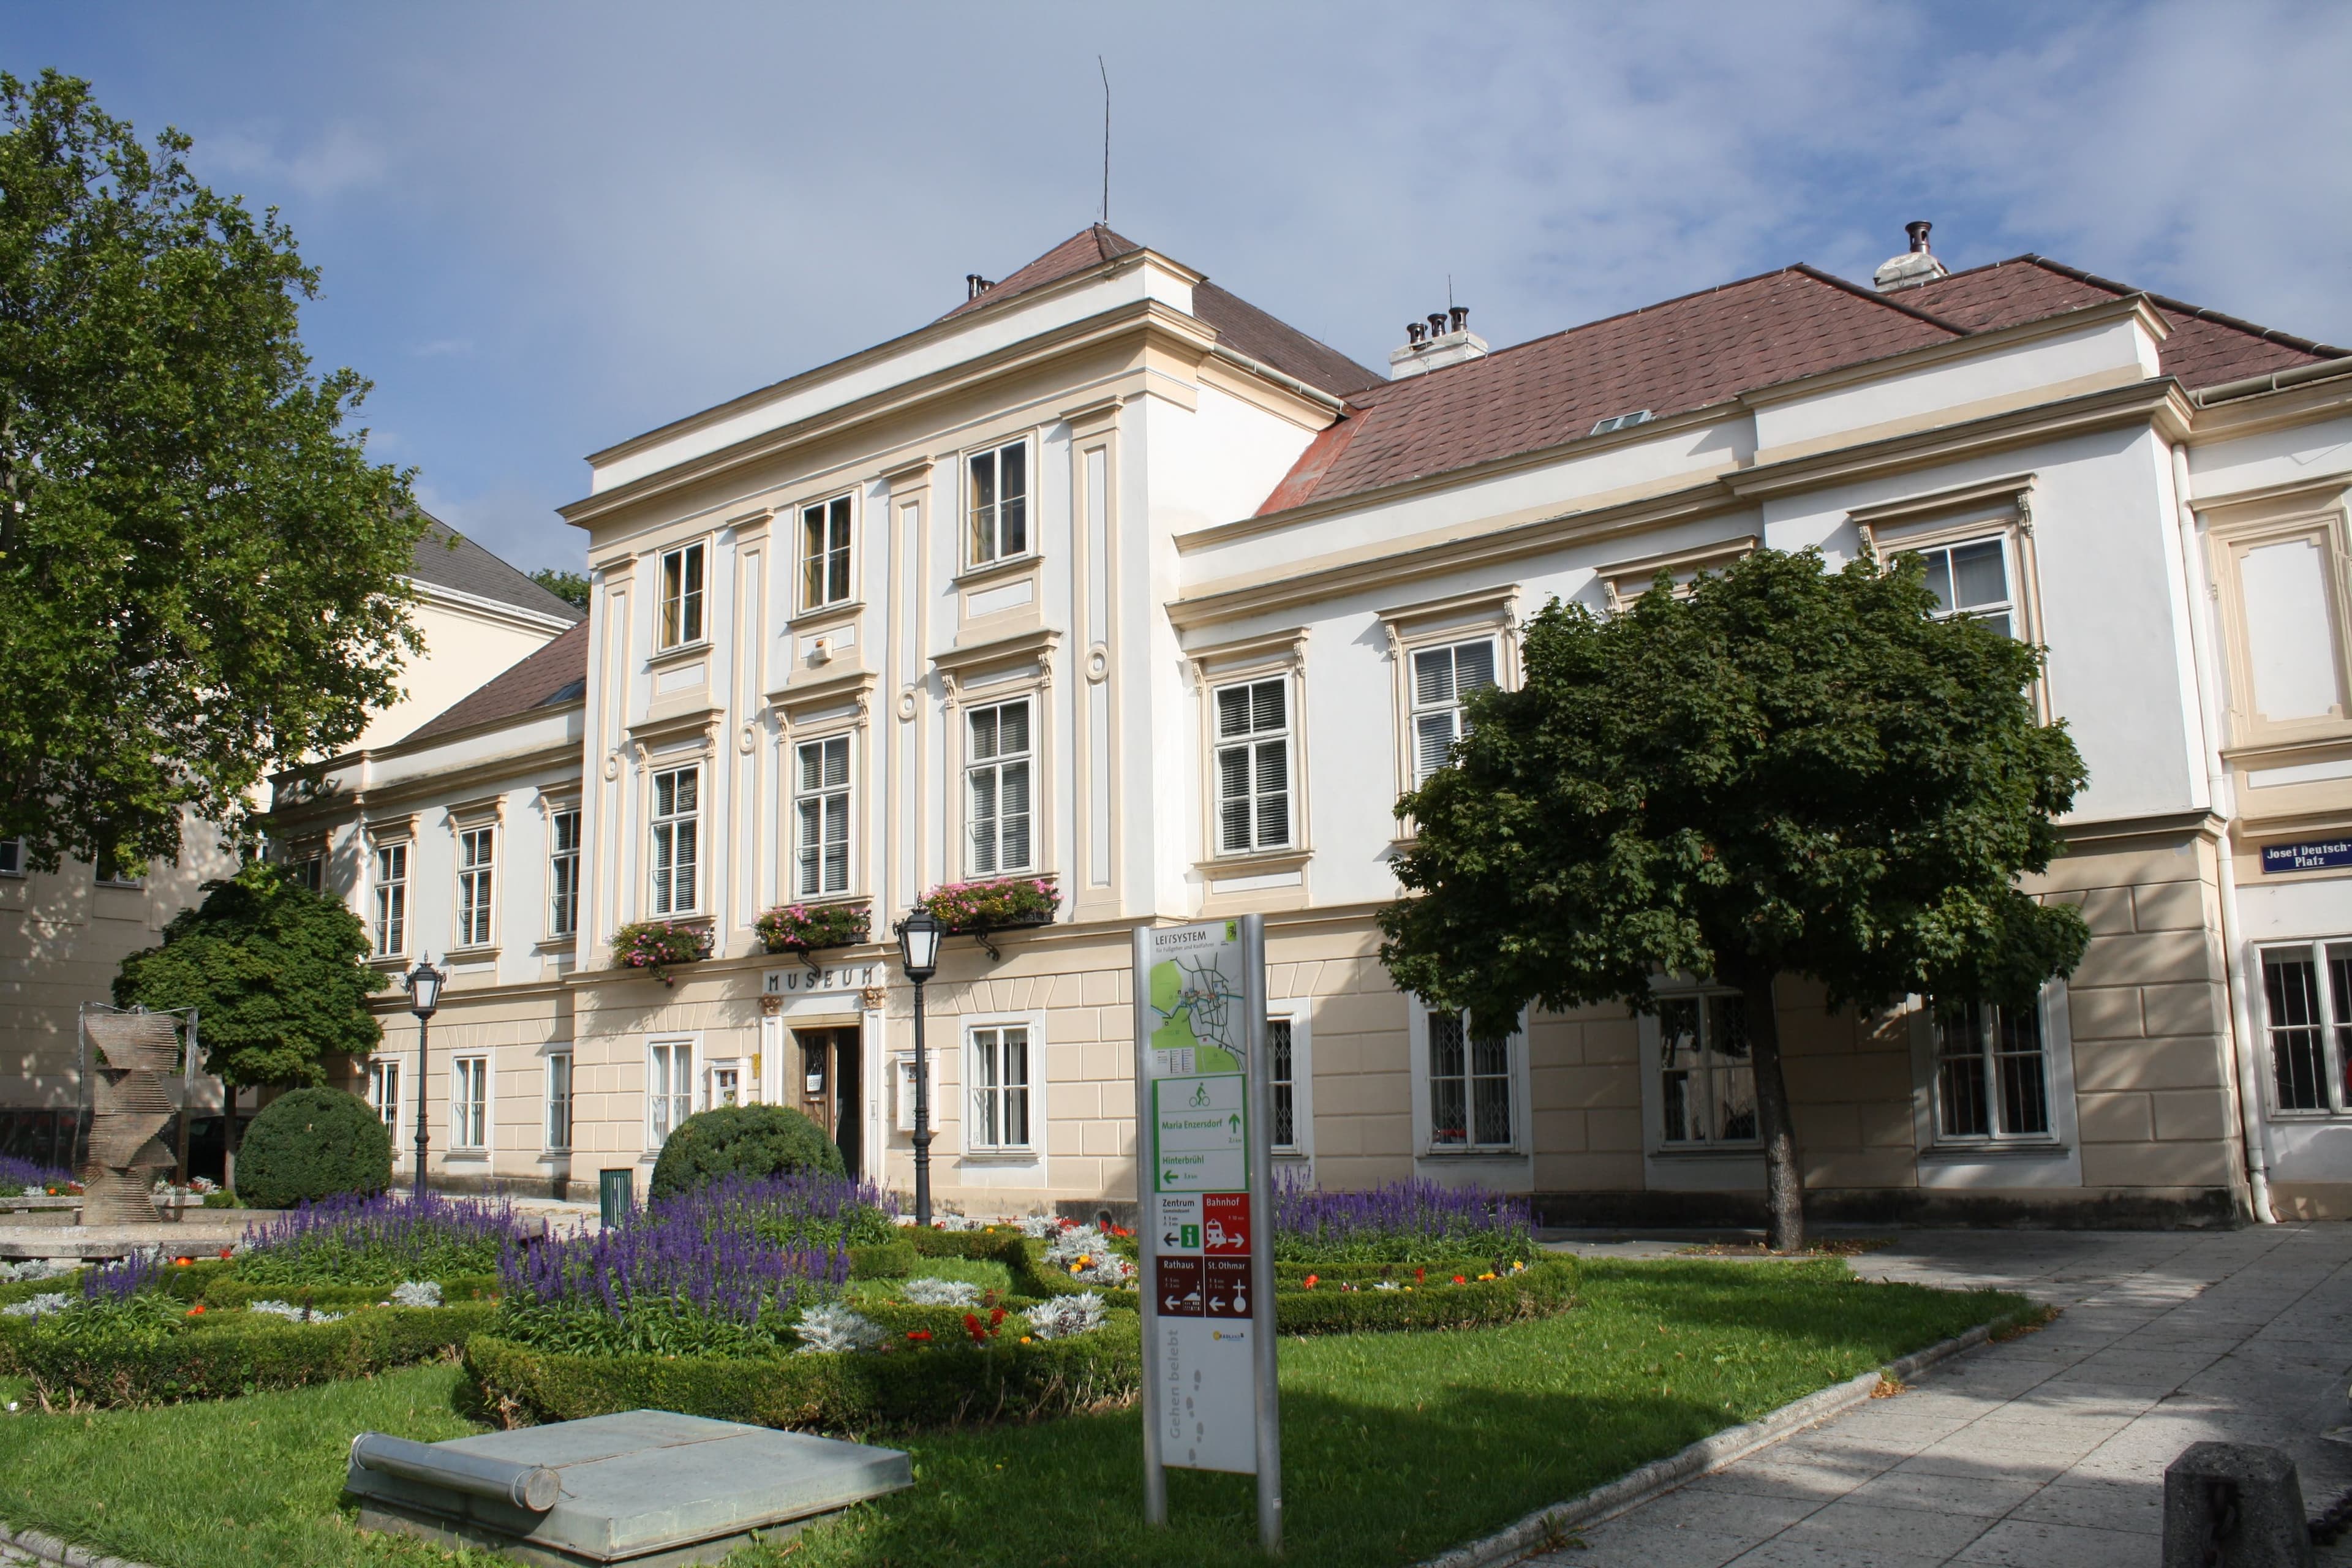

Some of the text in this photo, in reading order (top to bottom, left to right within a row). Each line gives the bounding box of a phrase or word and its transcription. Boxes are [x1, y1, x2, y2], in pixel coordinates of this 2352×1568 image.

[2267, 842, 2351, 859] Josef Deutsch-
[2295, 856, 2324, 867] Platz
[1156, 931, 1206, 945] LEITSYSTEM
[769, 967, 873, 992] MUSEUM
[1162, 1118, 1223, 1129] Maria Enzersdorf
[1163, 1155, 1204, 1164] Hinterbrühl
[1163, 1199, 1194, 1207] Zentrum
[1206, 1197, 1240, 1207] Bahnhof
[1164, 1260, 1194, 1269] Rathaus
[1208, 1261, 1245, 1270] St. Othmar
[1167, 1329, 1180, 1439] Gehen belebt
